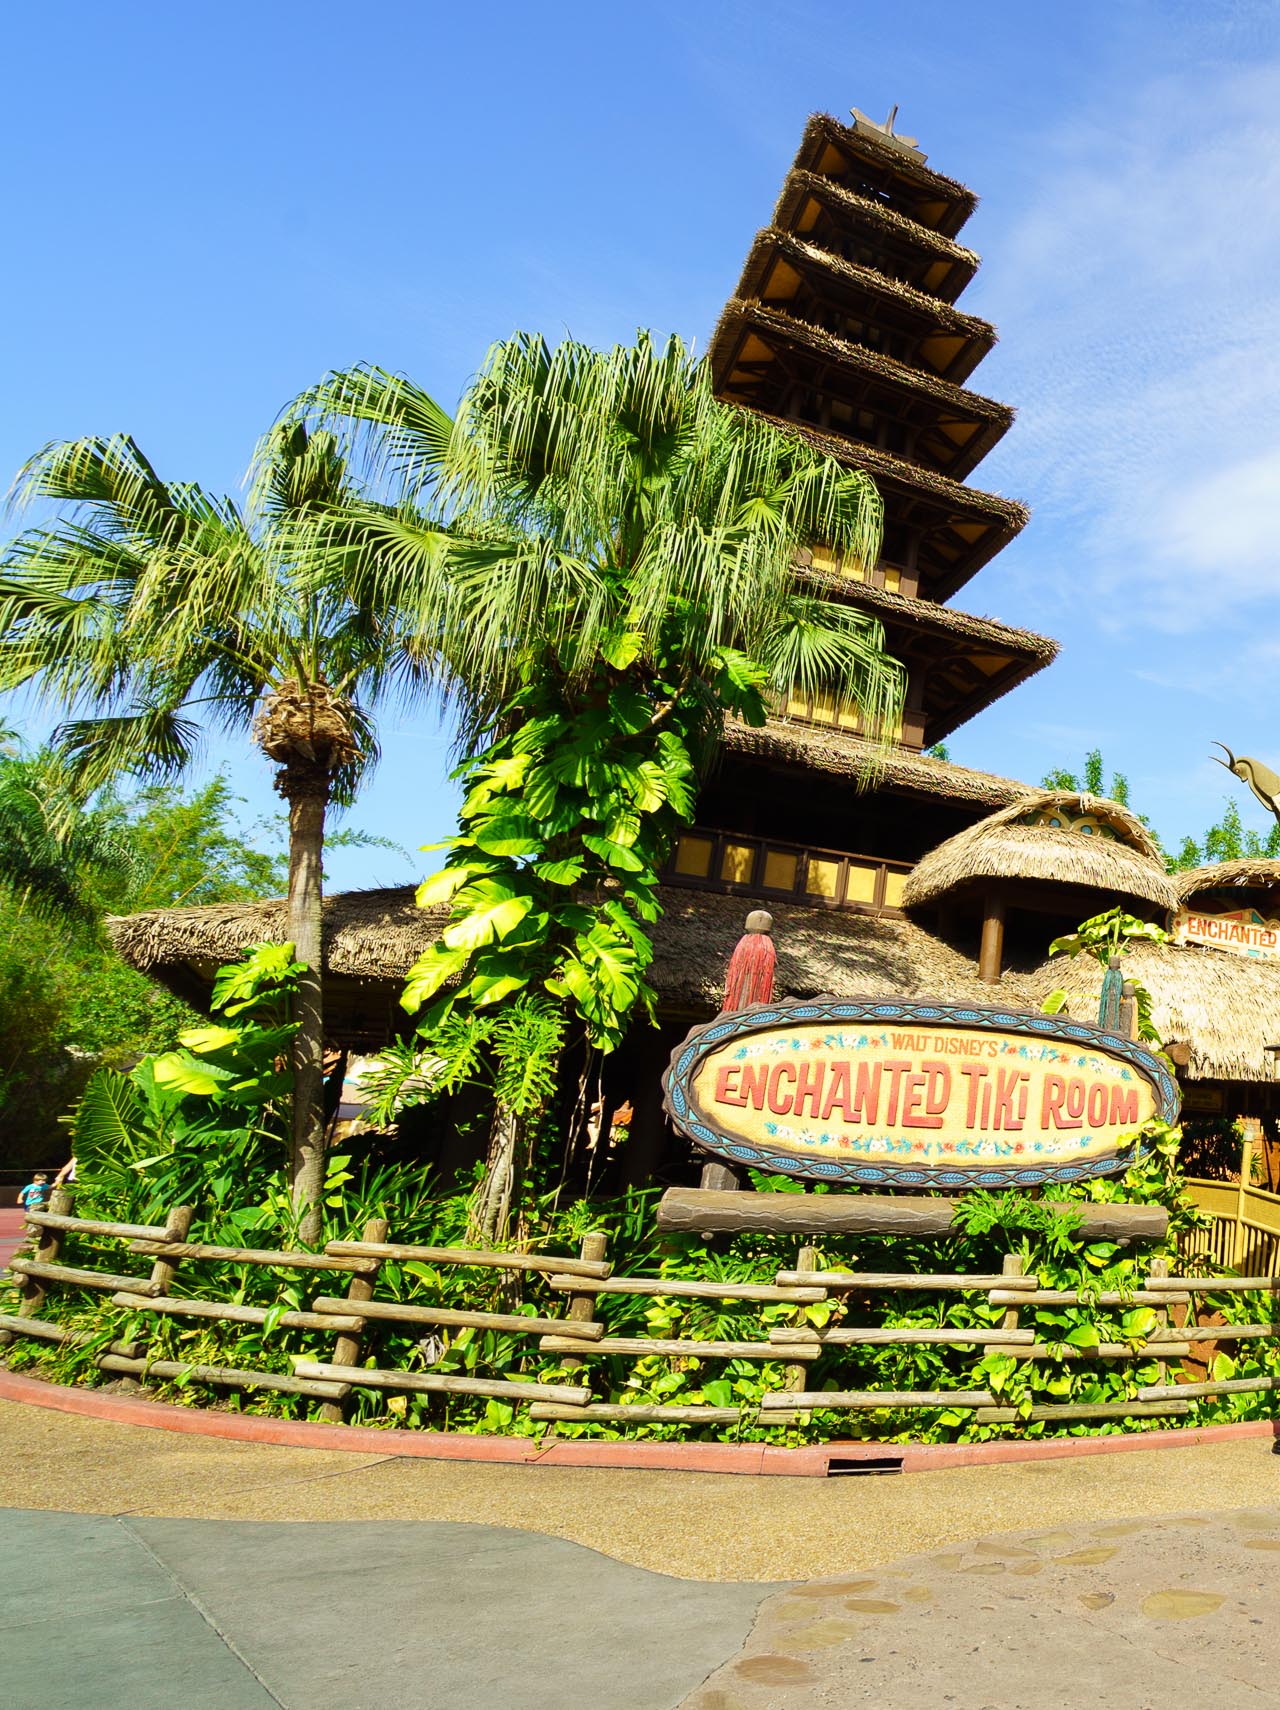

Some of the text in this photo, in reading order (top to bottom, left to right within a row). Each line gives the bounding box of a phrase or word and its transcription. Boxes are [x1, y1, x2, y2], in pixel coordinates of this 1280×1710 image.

[1187, 917, 1278, 948] ENCHANTED
[891, 1033, 999, 1058] WALT DISNEY'S
[715, 1060, 951, 1129] ENCHANTED
[1041, 1073, 1139, 1130] ROOM
